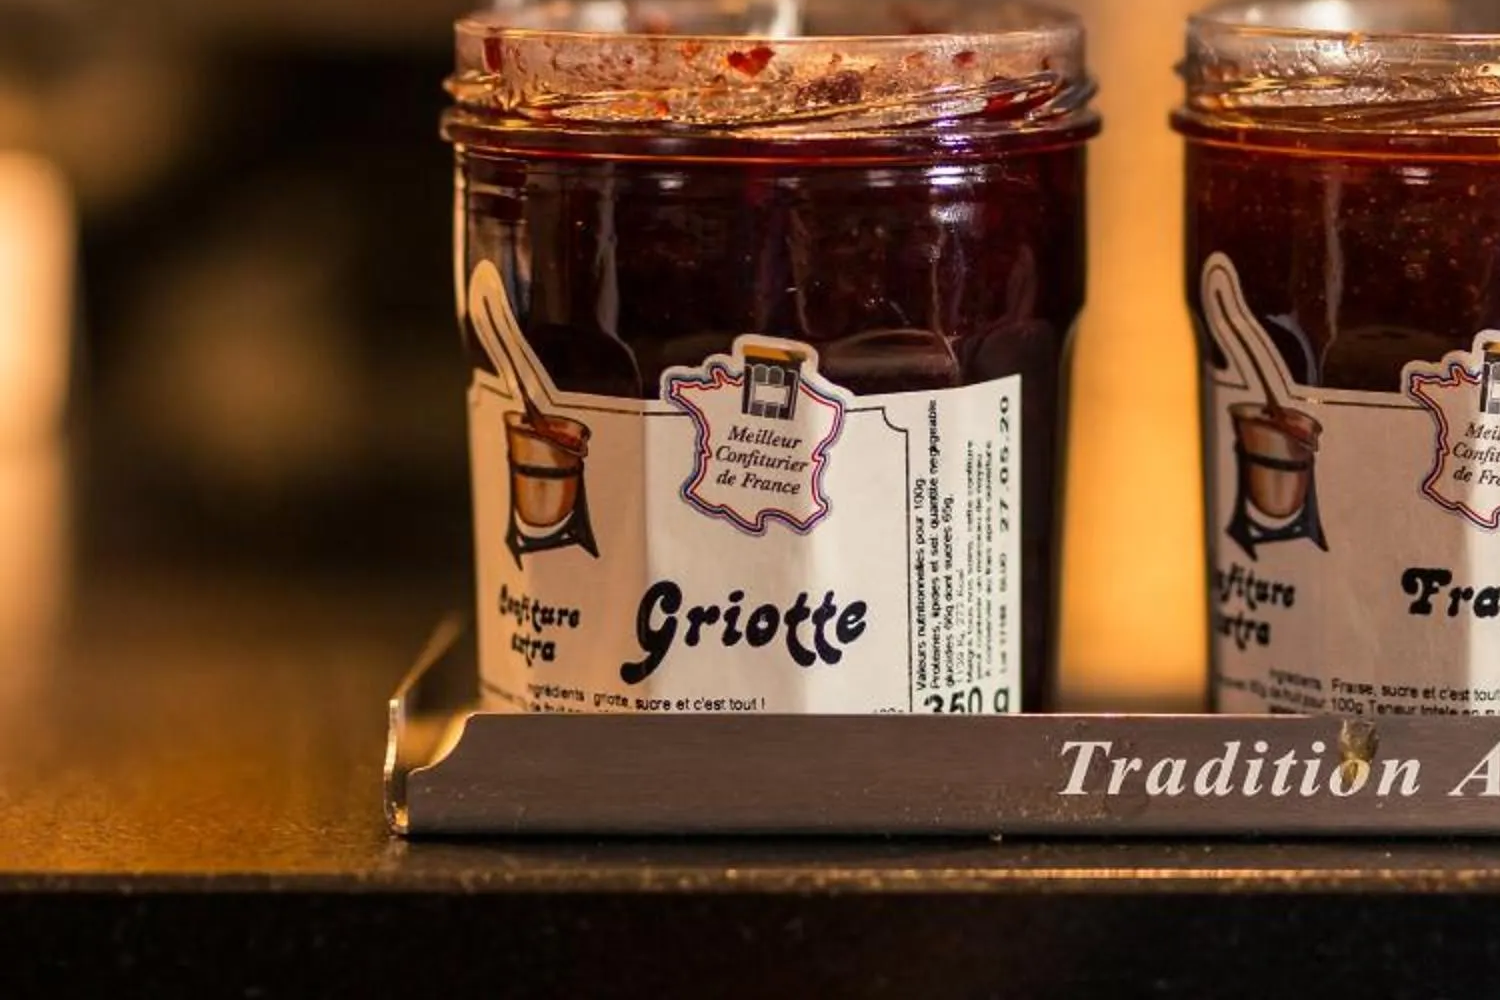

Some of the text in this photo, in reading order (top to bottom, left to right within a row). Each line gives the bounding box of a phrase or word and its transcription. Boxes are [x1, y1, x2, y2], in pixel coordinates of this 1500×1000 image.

[728, 425, 802, 449] Meilleur
[716, 445, 808, 472] Confiturier
[716, 469, 800, 494] de France
[1452, 465, 1473, 483] de
[916, 516, 925, 544] pour
[620, 580, 867, 685] Griotte
[635, 699, 671, 711] sucre
[676, 697, 690, 711] et
[694, 697, 726, 711] c'est
[729, 697, 757, 711] tout
[1381, 685, 1418, 697] sucre
[1423, 686, 1436, 699] et
[1439, 687, 1470, 701] c'est
[1474, 687, 1500, 700] tout
[1056, 739, 1420, 796] Tradition
